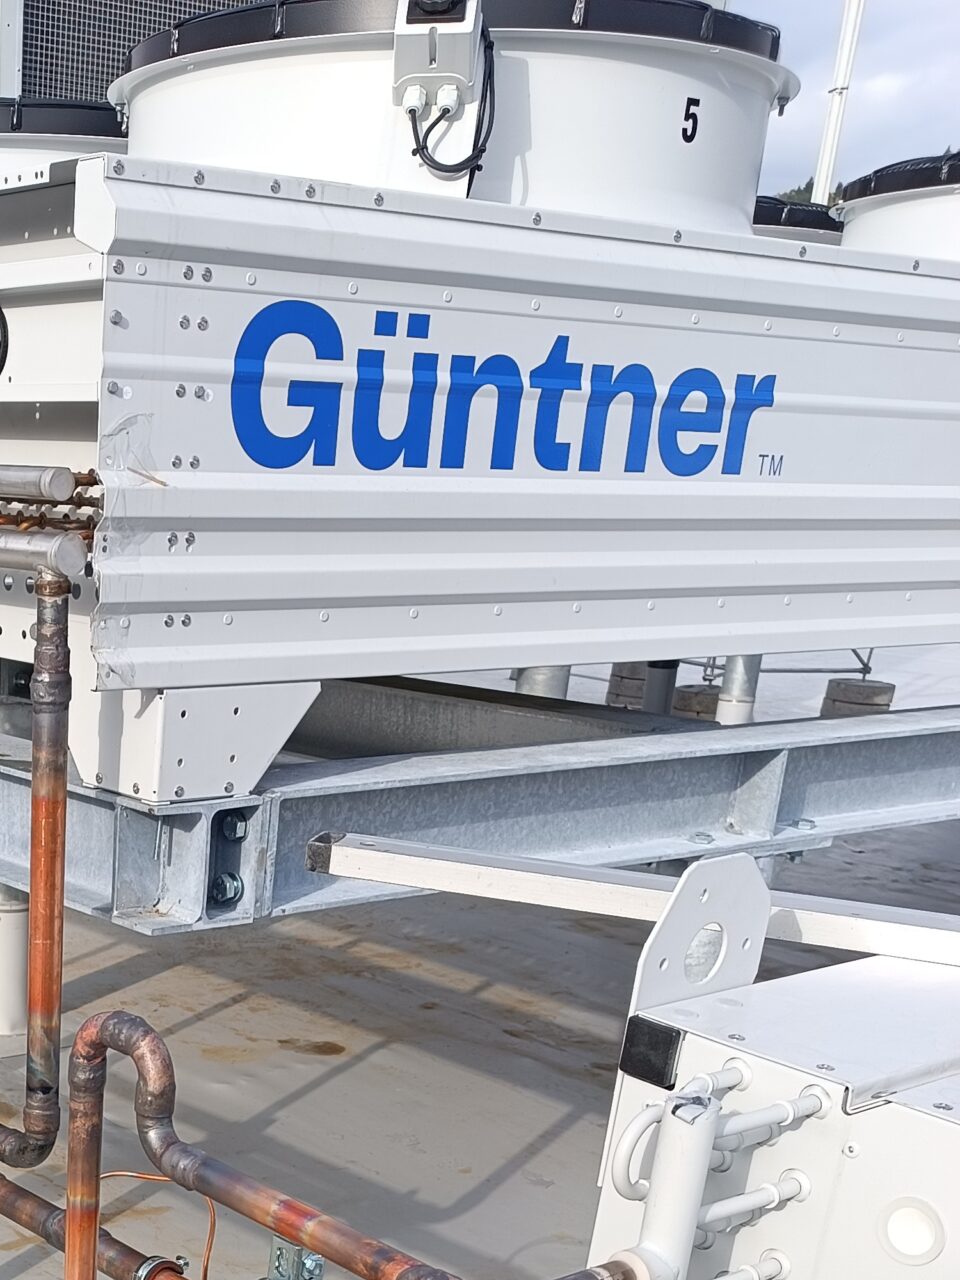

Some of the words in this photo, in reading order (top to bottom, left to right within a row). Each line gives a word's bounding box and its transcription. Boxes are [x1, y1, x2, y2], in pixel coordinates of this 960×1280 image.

[682, 97, 700, 143] 5
[231, 300, 776, 476] Güntner
[758, 454, 783, 476] TM
